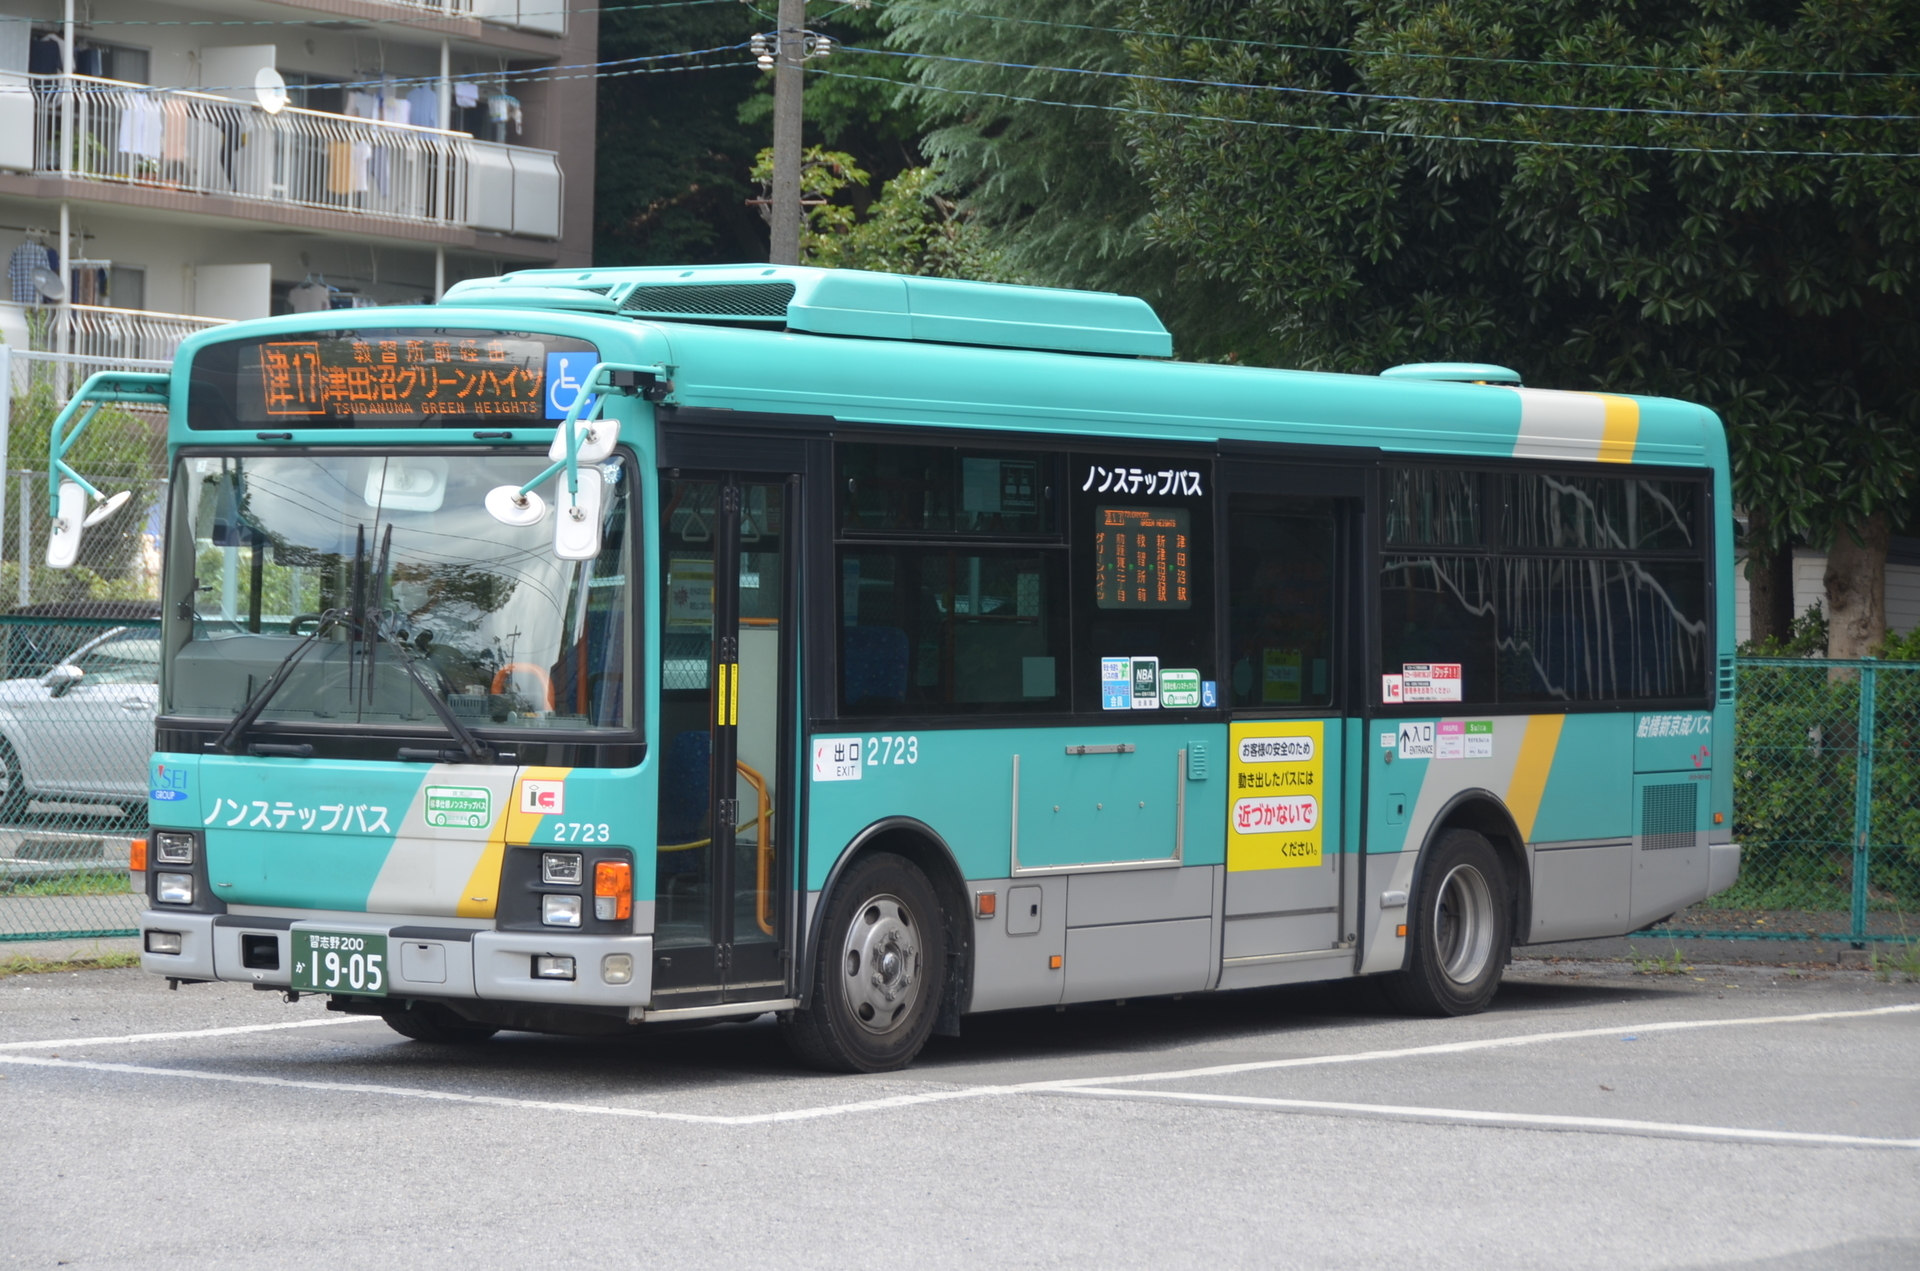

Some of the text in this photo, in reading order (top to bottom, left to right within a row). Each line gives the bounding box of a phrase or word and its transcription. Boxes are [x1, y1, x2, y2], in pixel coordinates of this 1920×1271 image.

[352, 340, 505, 363] 教習所前経由
[321, 365, 543, 401] 津田沼グリーンハイツ
[333, 402, 538, 414] TSUDANUMA GREEN HEIGHTS
[1082, 465, 1203, 496] ノンステップバス
[1136, 668, 1153, 681] NBA
[1412, 726, 1431, 743] 入口
[1469, 723, 1487, 732] Suica
[1636, 714, 1712, 738] 船橋新京成バス
[834, 743, 859, 762] 出口
[867, 736, 918, 766] 2723
[1242, 742, 1311, 758] お客様の安全のため
[1409, 745, 1433, 755] ENTRANCE
[836, 765, 856, 777] EXIT
[1238, 771, 1314, 789] 動き出したバスには
[155, 790, 176, 800] GROUP
[429, 799, 487, 811] 標準仕様ノンステップバス
[203, 797, 391, 834] ノンステップバス
[1238, 803, 1313, 828] 近づかないで
[554, 823, 610, 843] 2723
[1281, 842, 1318, 857] ください。
[295, 961, 306, 974] か
[312, 951, 382, 991] 19-05
